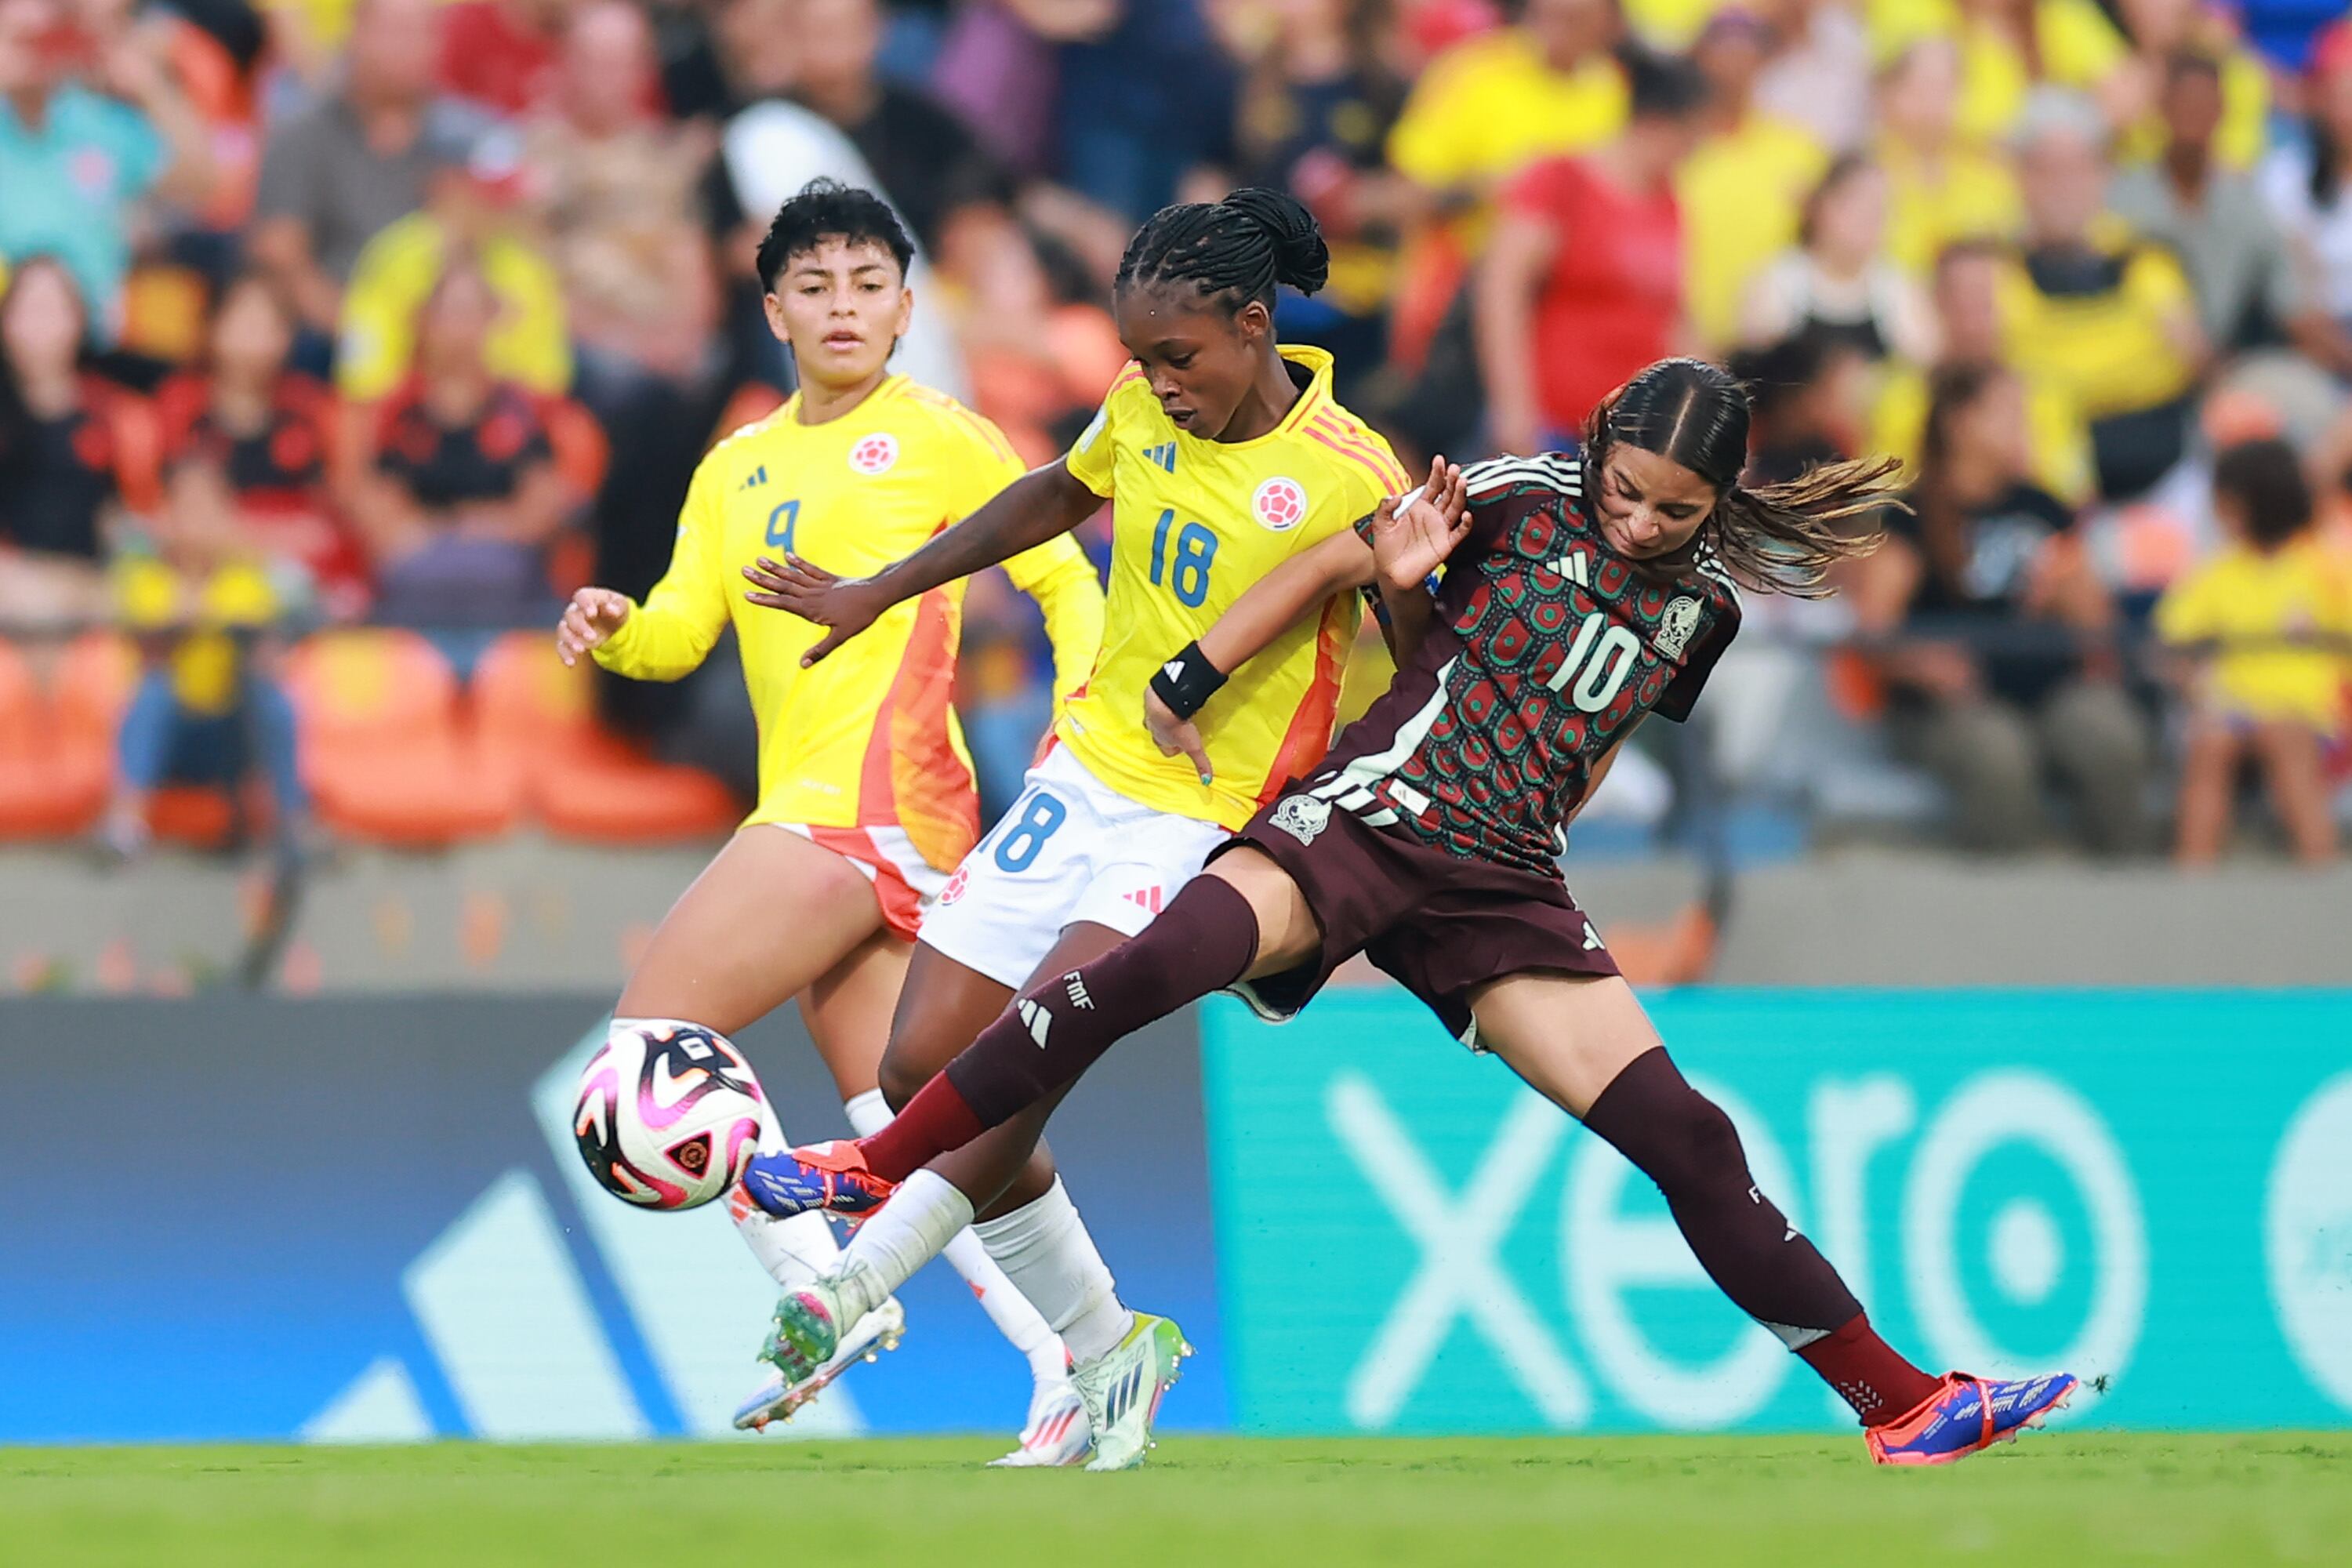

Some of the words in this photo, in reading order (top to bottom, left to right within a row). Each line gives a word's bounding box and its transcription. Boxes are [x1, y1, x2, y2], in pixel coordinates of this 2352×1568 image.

[764, 499, 801, 570] 9
[1150, 508, 1218, 608] 18
[1546, 612, 1641, 713] 10
[1063, 970, 1095, 1011] FMF
[1325, 1066, 2150, 1428] xero
